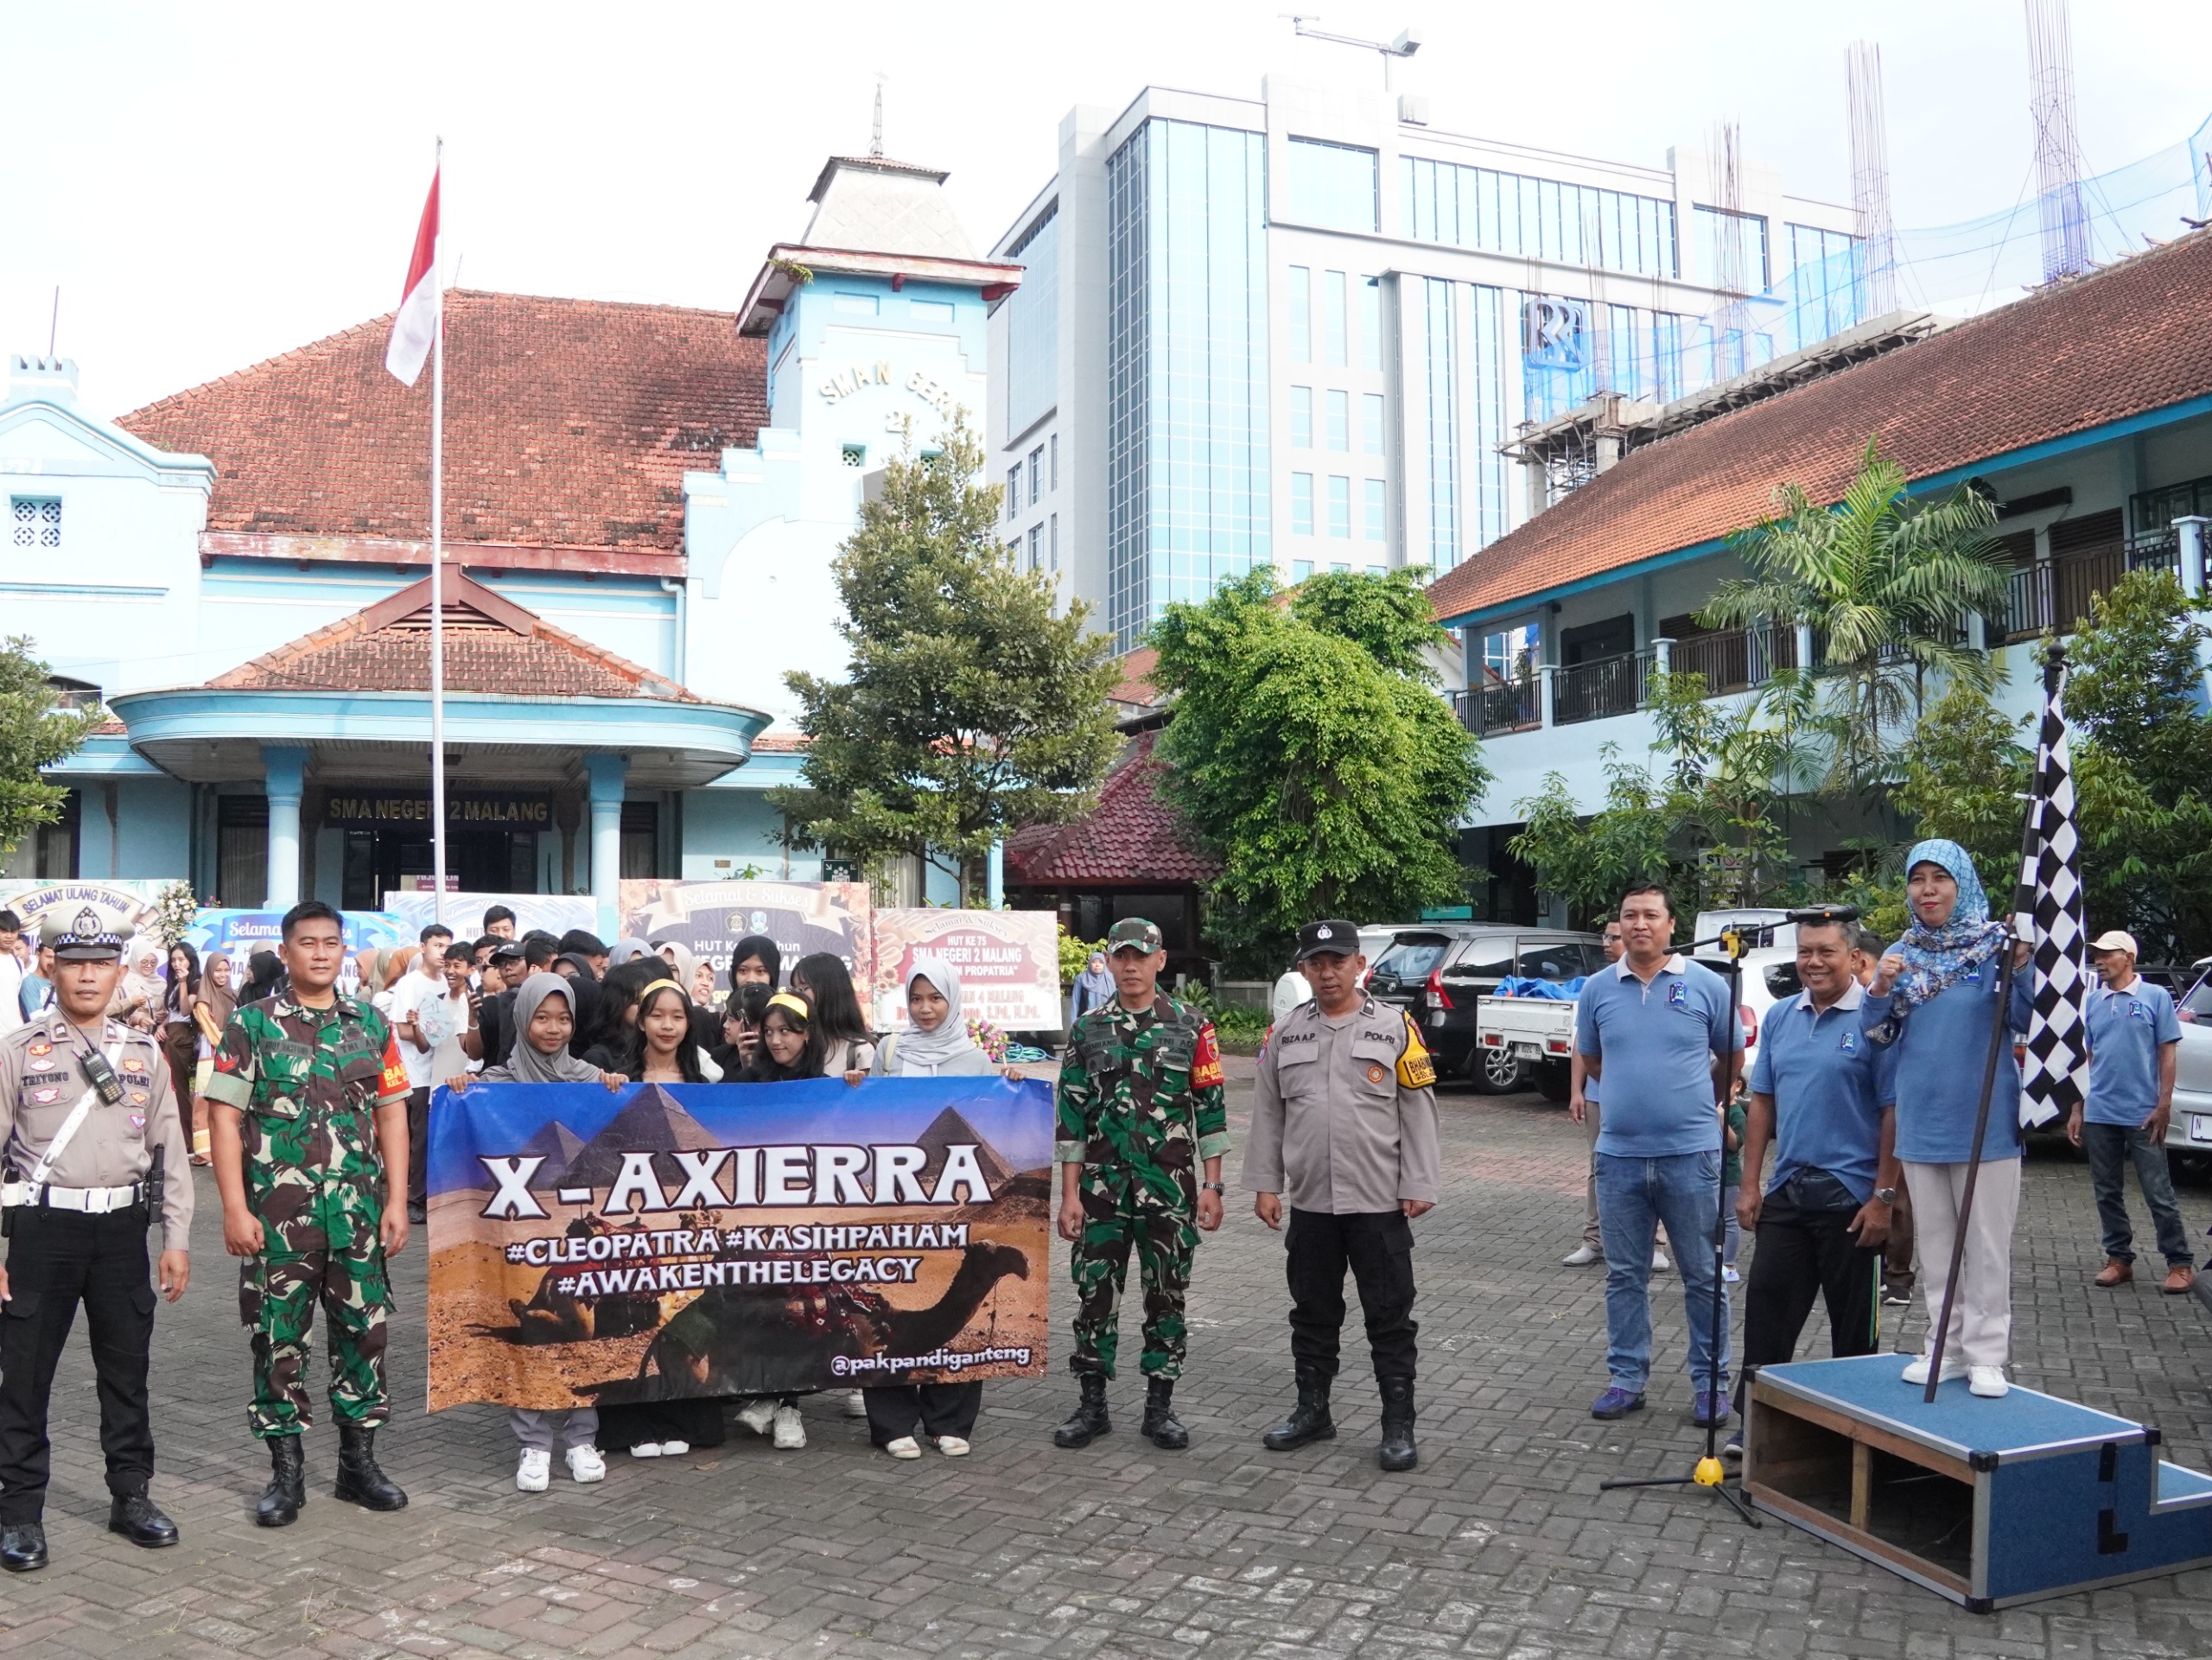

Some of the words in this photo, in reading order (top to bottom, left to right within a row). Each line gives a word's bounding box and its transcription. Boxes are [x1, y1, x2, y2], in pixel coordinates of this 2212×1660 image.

[329, 798, 372, 818] SMA
[449, 801, 461, 819] 2
[464, 801, 547, 820] MALANG
[22, 888, 63, 914] SELAMAT
[67, 887, 99, 901] ULANG
[99, 891, 130, 913] TAHUN
[684, 889, 742, 906] Selamat
[747, 887, 758, 901] &
[761, 888, 809, 908] Sukses
[446, 900, 481, 924] elamat
[229, 921, 283, 937] Selama
[925, 918, 963, 934] Selamat
[977, 917, 1007, 937] Sukses
[695, 941, 721, 951] HUT
[947, 936, 963, 946] HUT
[965, 936, 976, 946] KE
[977, 936, 987, 946] 75
[912, 948, 934, 963] SMA
[937, 948, 972, 963] NEGERI
[974, 948, 981, 963] 2
[983, 948, 1022, 963] MALANG
[965, 965, 1018, 976] PROPATRIA"
[988, 990, 1024, 1003] MALANG
[1159, 1037, 1174, 1046] TNI
[1281, 1034, 1300, 1045] RIZA
[1363, 1031, 1395, 1045] POLRI
[22, 1072, 70, 1086] TRIYONO
[119, 1073, 149, 1088] POLRI
[2196, 1117, 2202, 1131] N
[478, 1154, 550, 1220] X
[558, 1186, 594, 1204] -
[601, 1143, 994, 1215] AXIERRA
[506, 1228, 720, 1264] #CLEOPATRA
[726, 1224, 969, 1251] #KASIHPAHAM
[558, 1257, 922, 1296] #AWAKENTHELEGACY
[831, 1347, 1031, 1377] @pakpandiganteng
